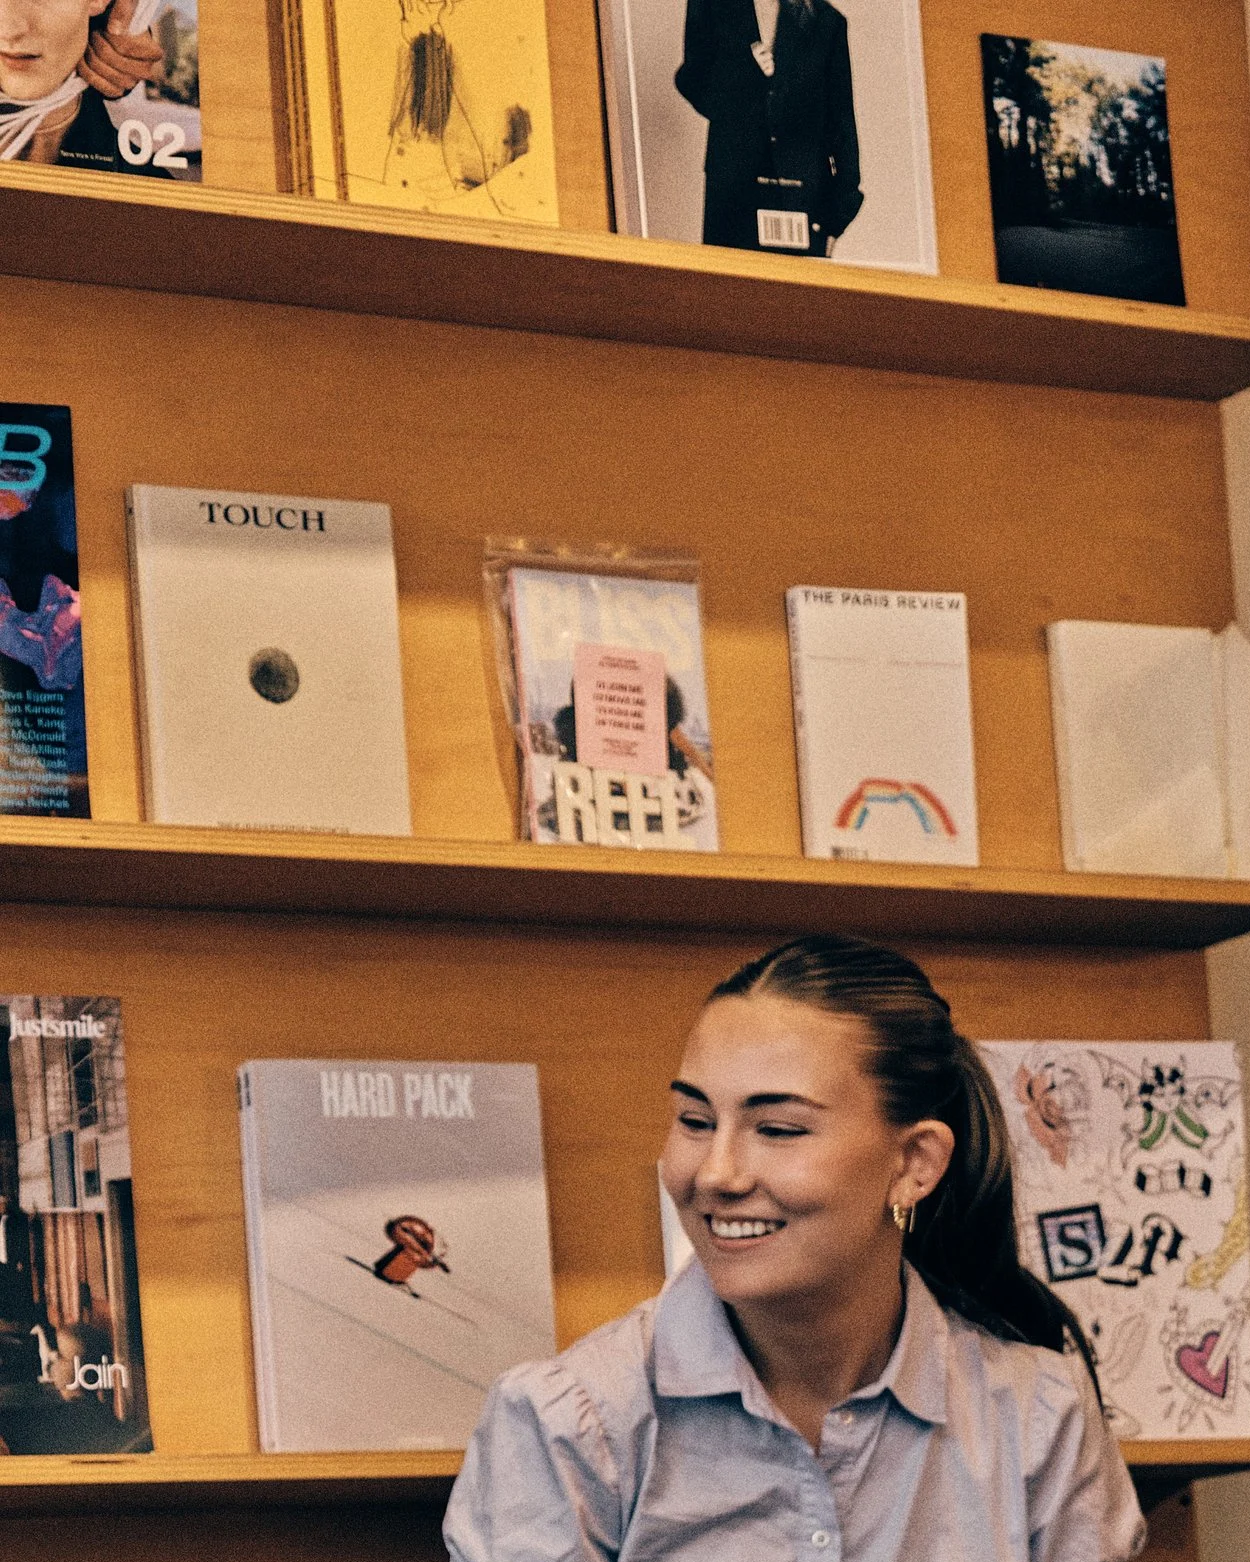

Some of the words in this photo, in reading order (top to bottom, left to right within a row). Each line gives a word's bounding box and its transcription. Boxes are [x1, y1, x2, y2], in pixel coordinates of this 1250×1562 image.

[117, 119, 188, 169] 02
[200, 501, 325, 532] TOUCH
[802, 589, 833, 604] THE
[841, 592, 889, 608] PARIS
[897, 596, 960, 610] REVIEW
[8, 1014, 106, 1041] Justsmile
[319, 1071, 397, 1119] HARD
[403, 1072, 475, 1120] PACK
[66, 1355, 128, 1391] Jain
